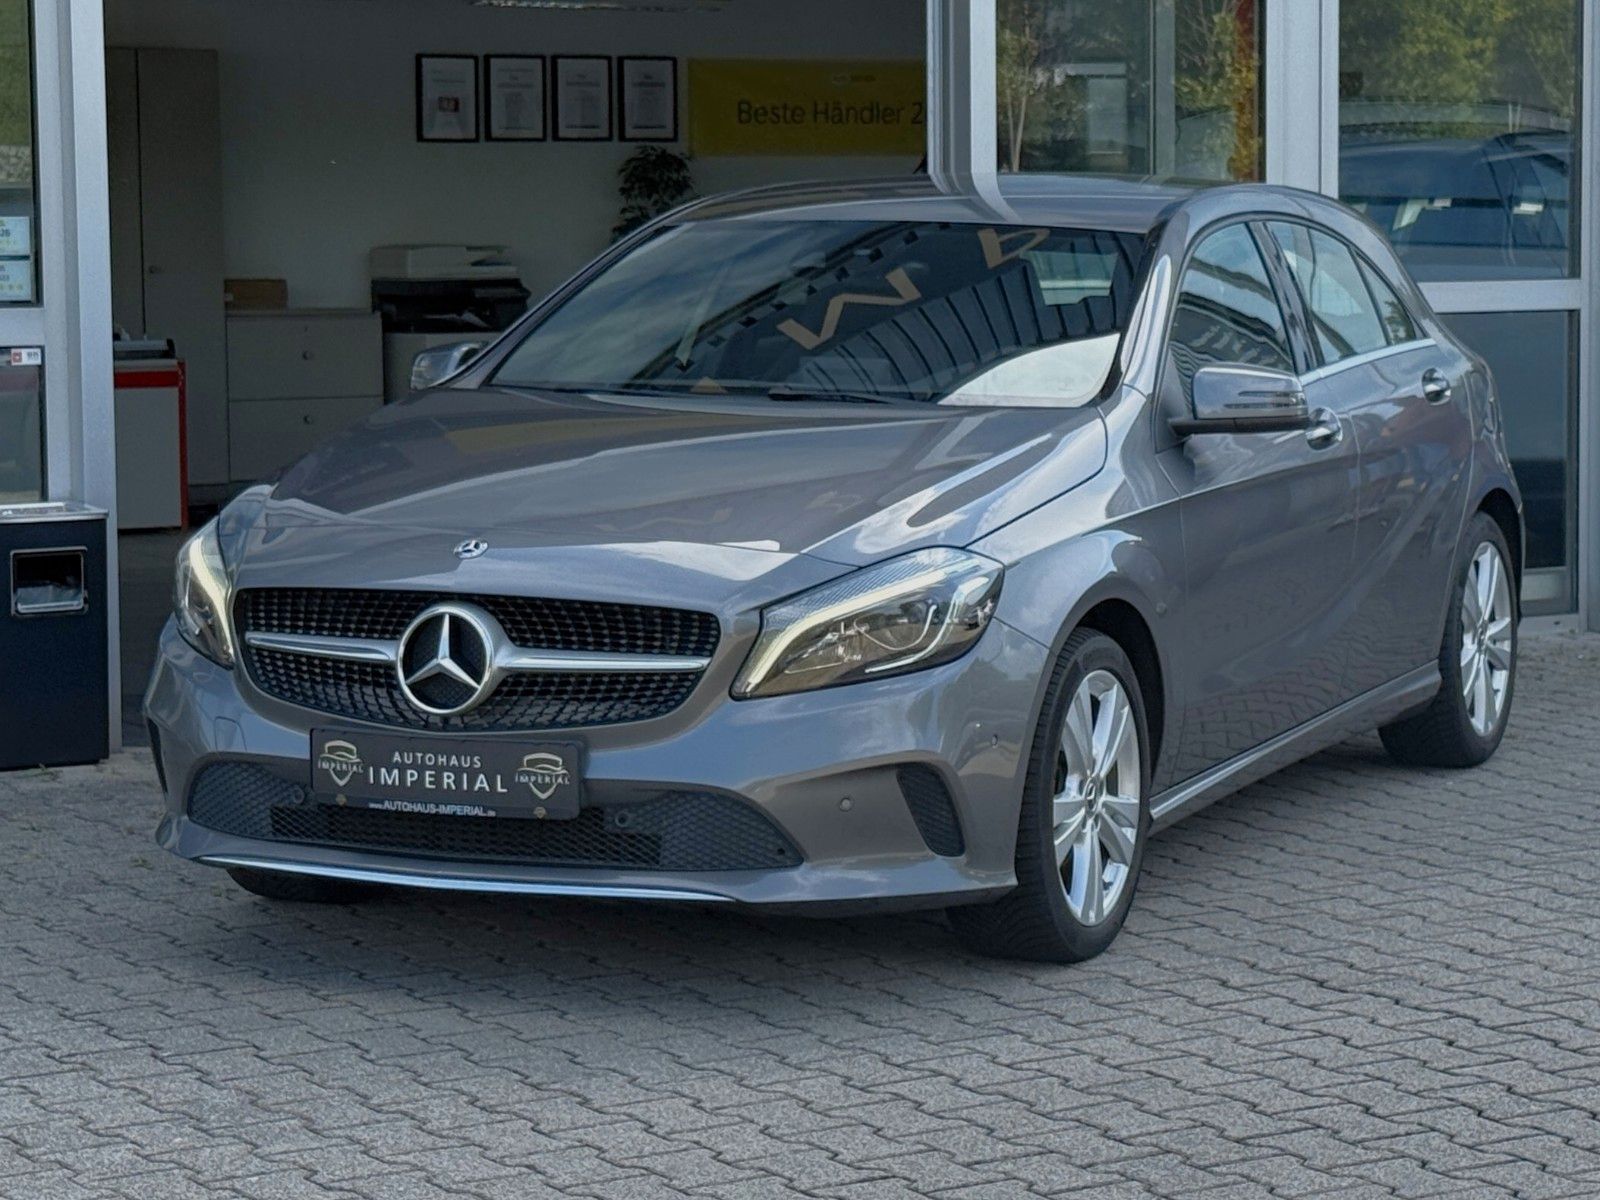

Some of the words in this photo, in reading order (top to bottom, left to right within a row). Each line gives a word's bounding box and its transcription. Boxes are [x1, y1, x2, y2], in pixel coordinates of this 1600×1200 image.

[737, 101, 805, 125] Beste
[813, 101, 904, 125] Händler
[318, 760, 364, 774] IMPERIAL
[393, 751, 482, 769] AUTOHAUS
[368, 767, 508, 793] IMPERIAL
[515, 773, 570, 786] IMPERIAL
